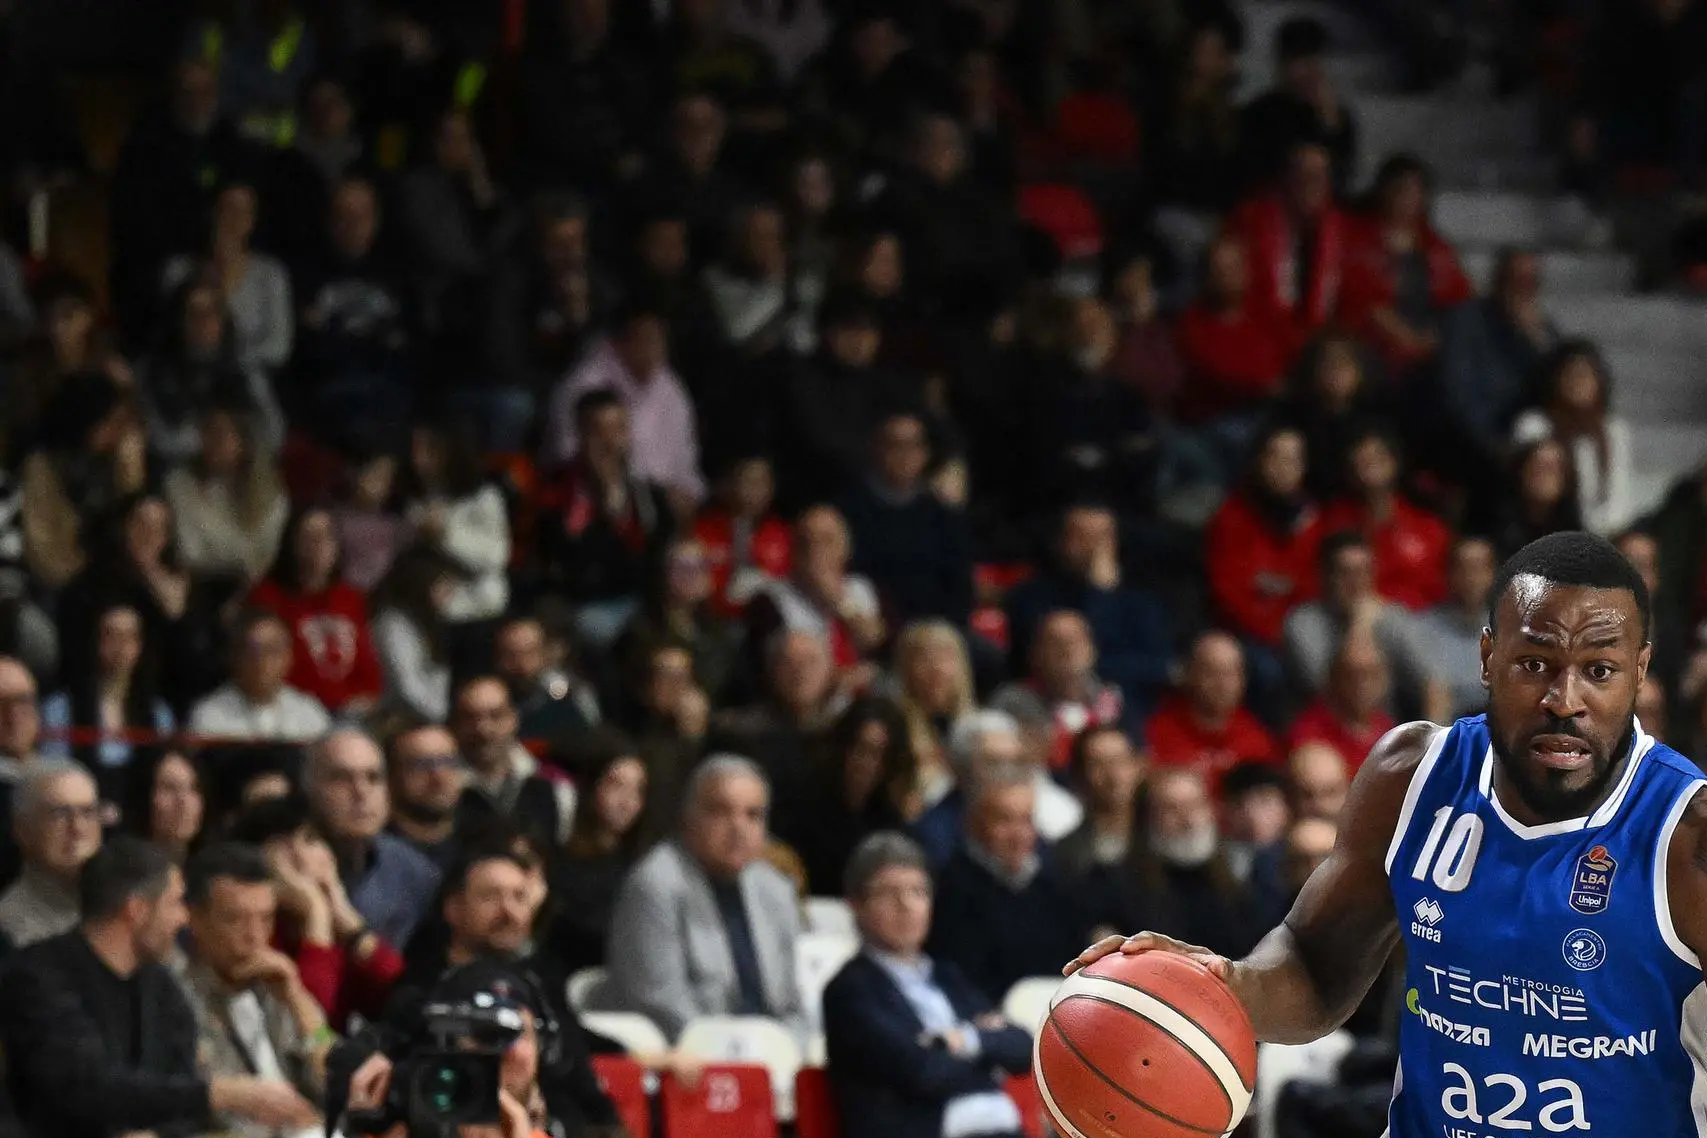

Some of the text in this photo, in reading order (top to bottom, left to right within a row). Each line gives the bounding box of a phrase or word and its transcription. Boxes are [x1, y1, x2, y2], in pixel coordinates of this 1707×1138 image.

[1411, 806, 1484, 892] 10
[1580, 872, 1607, 886] LBA
[1578, 895, 1602, 907] Unipol
[1411, 922, 1442, 943] errea
[1425, 965, 1588, 1021] TECHNE
[1502, 974, 1585, 998] METROLOGIA
[1522, 1029, 1657, 1059] MEGRANI
[1441, 1062, 1591, 1132] a2a
